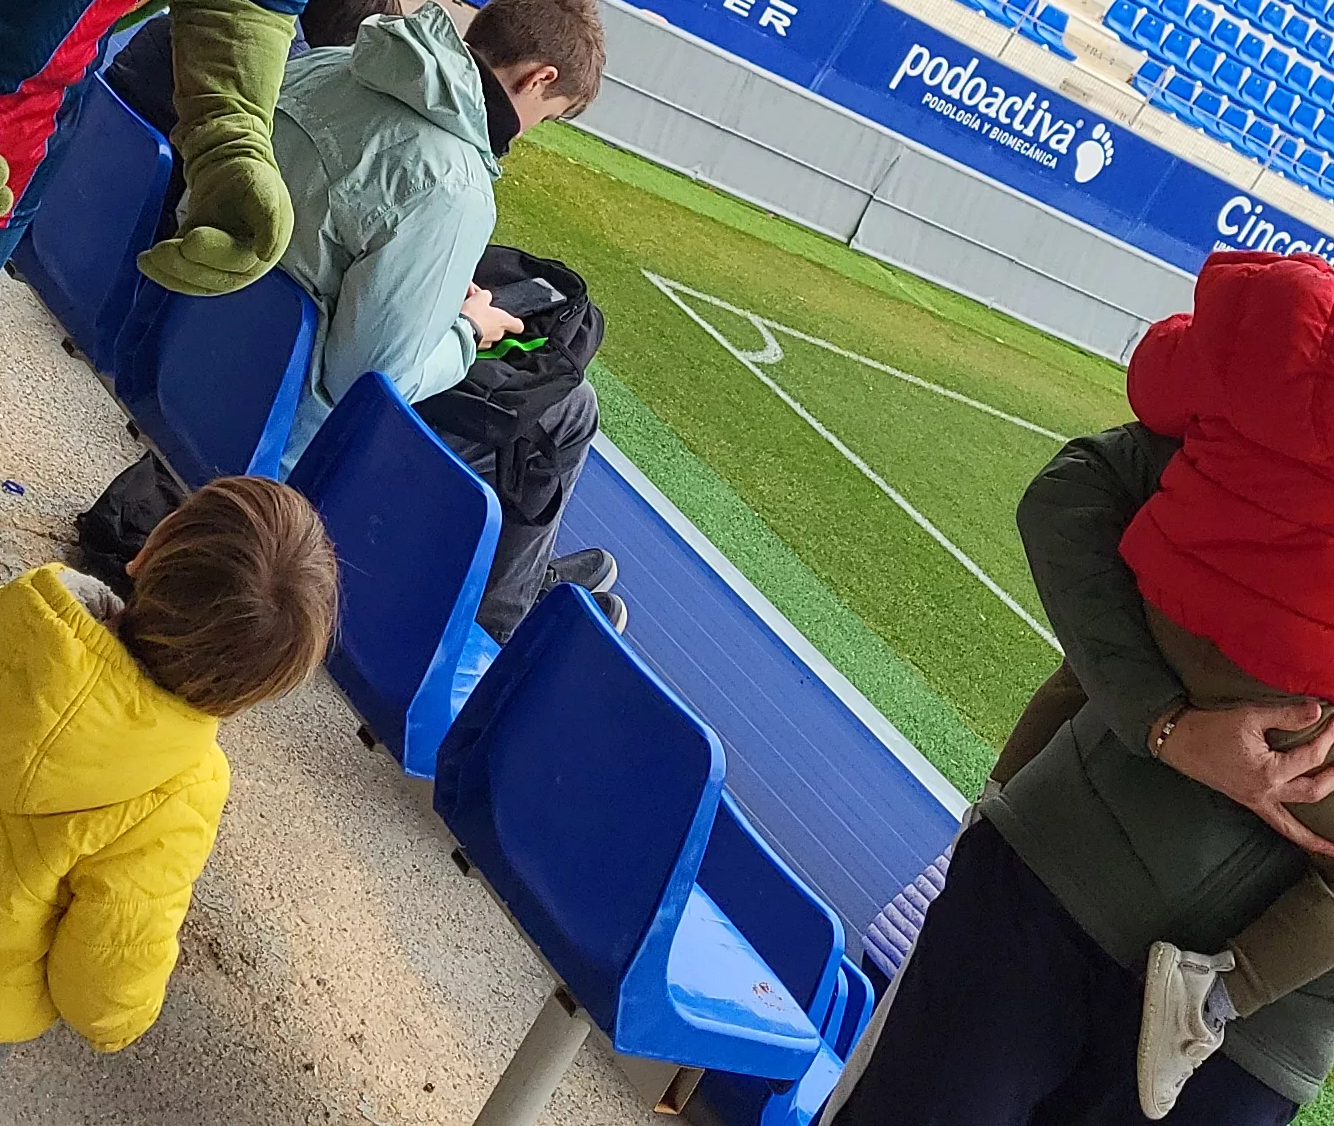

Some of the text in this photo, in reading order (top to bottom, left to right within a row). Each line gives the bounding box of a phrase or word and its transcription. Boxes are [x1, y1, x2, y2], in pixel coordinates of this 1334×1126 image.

[888, 43, 1077, 153] podoactiva
[921, 92, 1059, 171] PODOLOGÍA Y BIOMECÁNICA
